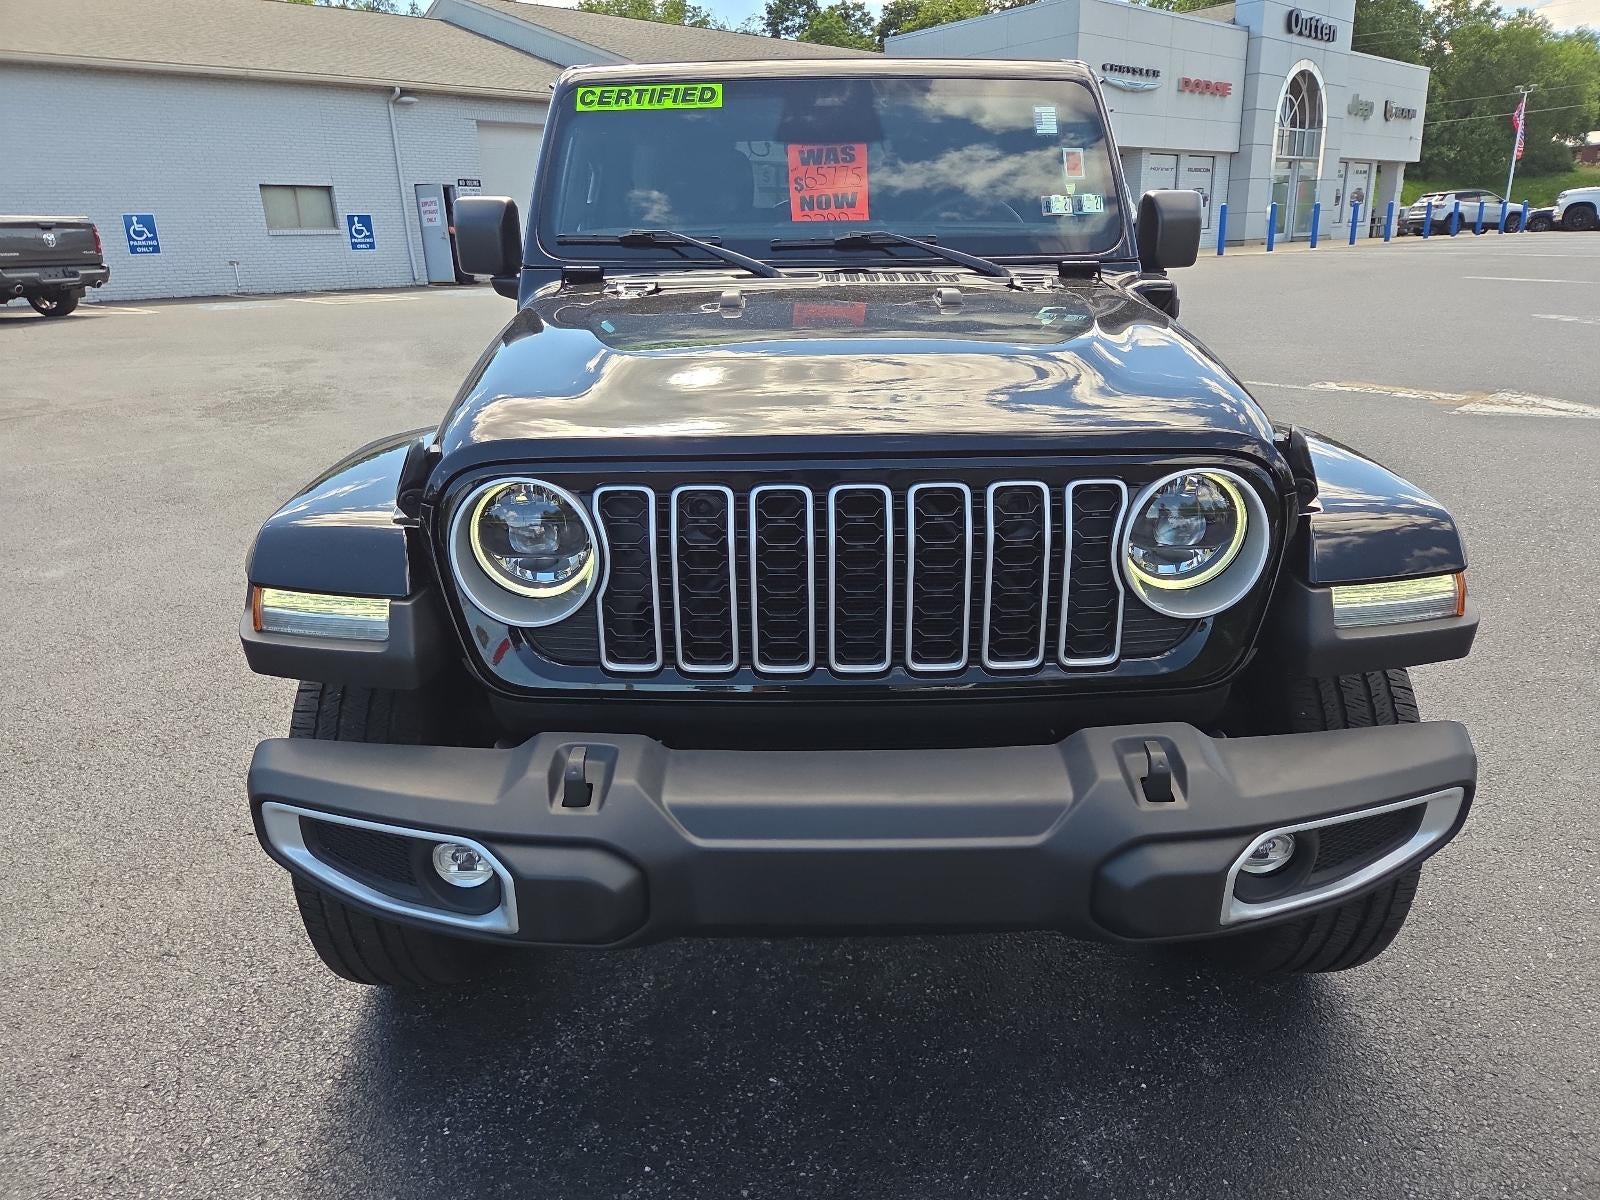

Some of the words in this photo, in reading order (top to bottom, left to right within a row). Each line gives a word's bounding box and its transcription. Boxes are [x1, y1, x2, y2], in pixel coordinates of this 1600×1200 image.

[1286, 8, 1337, 42] Outten
[1102, 62, 1160, 78] CHRYSLER
[579, 86, 718, 106] CERTIFIED
[1178, 77, 1232, 96] DODGE
[1348, 94, 1374, 121] Jeep
[799, 144, 856, 166] WAS
[800, 192, 858, 211] NOW
